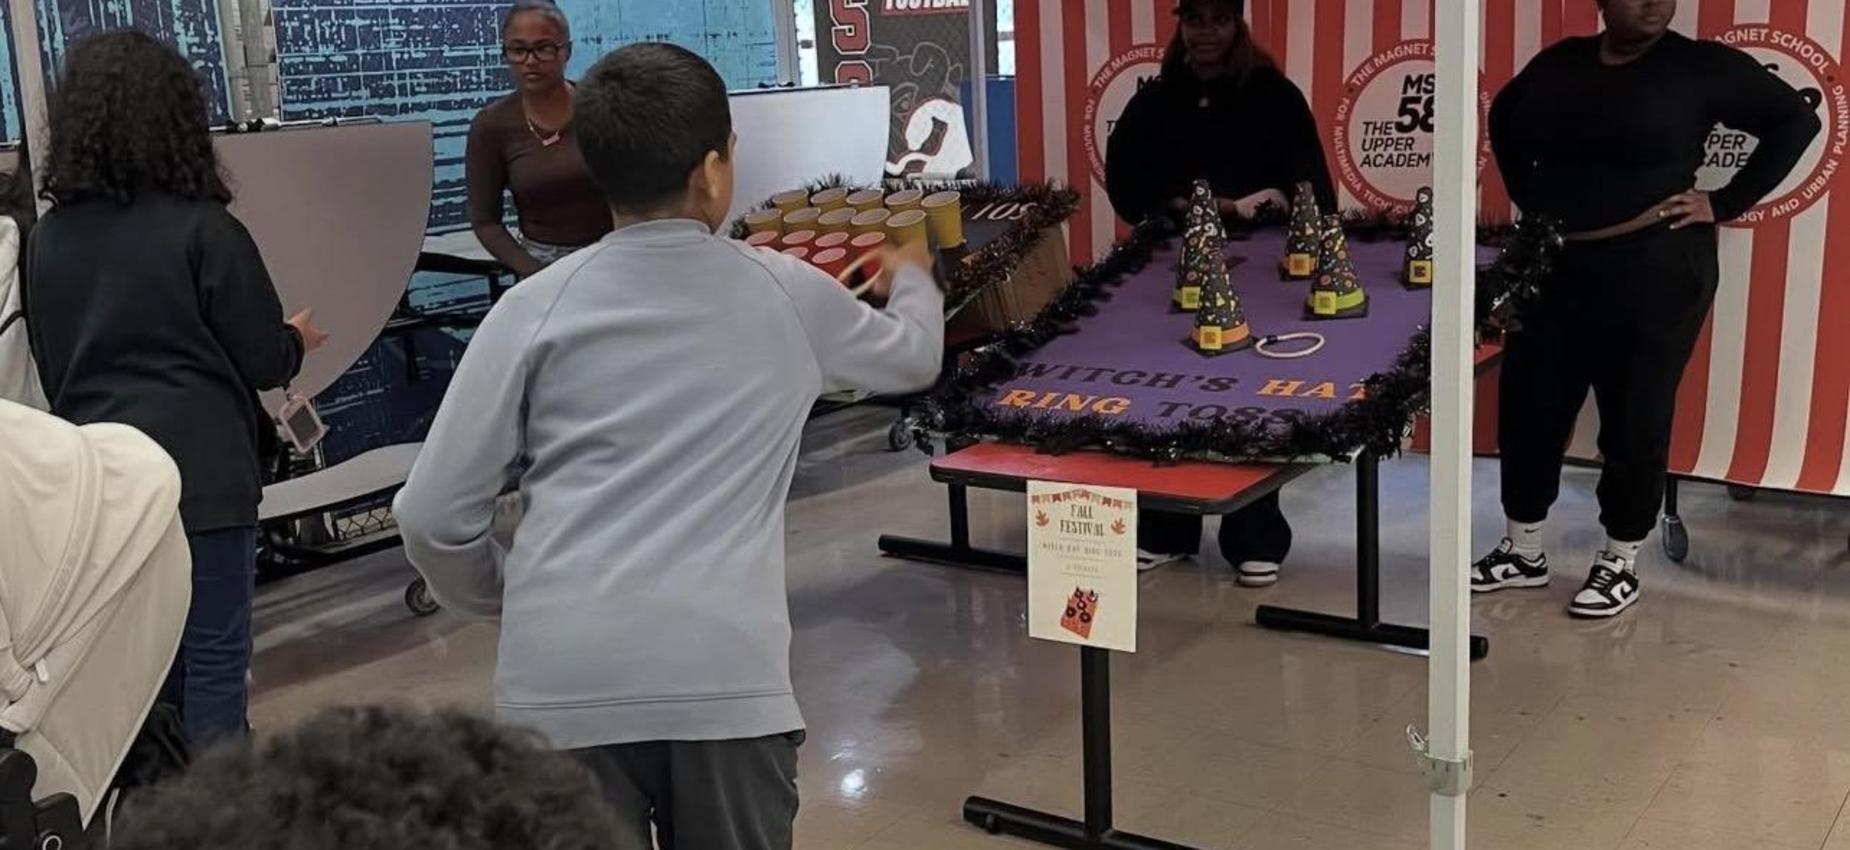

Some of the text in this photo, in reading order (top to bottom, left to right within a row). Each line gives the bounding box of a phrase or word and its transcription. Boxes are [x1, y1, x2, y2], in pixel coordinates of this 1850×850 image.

[1770, 31, 1831, 75] SCHOOL
[1094, 70, 1113, 89] THE
[1111, 48, 1157, 71] MAGNET
[1350, 66, 1374, 87] THE
[1374, 43, 1430, 69] MAGNET
[1402, 74, 1435, 95] MS
[1084, 99, 1096, 120] FOR
[1336, 97, 1350, 122] FOR
[1832, 84, 1850, 156] PLANNING
[1362, 121, 1394, 137] THE
[1361, 137, 1415, 152] UPPER
[1707, 134, 1747, 150] PER
[1360, 152, 1435, 168] ACADEM
[1802, 159, 1839, 200] URBAN
[1771, 198, 1800, 218] AND
[1016, 362, 1239, 392] WITCH'S
[995, 389, 1132, 415] RING
[1071, 504, 1094, 519] FALL
[1060, 519, 1104, 537] FESTIVAL
